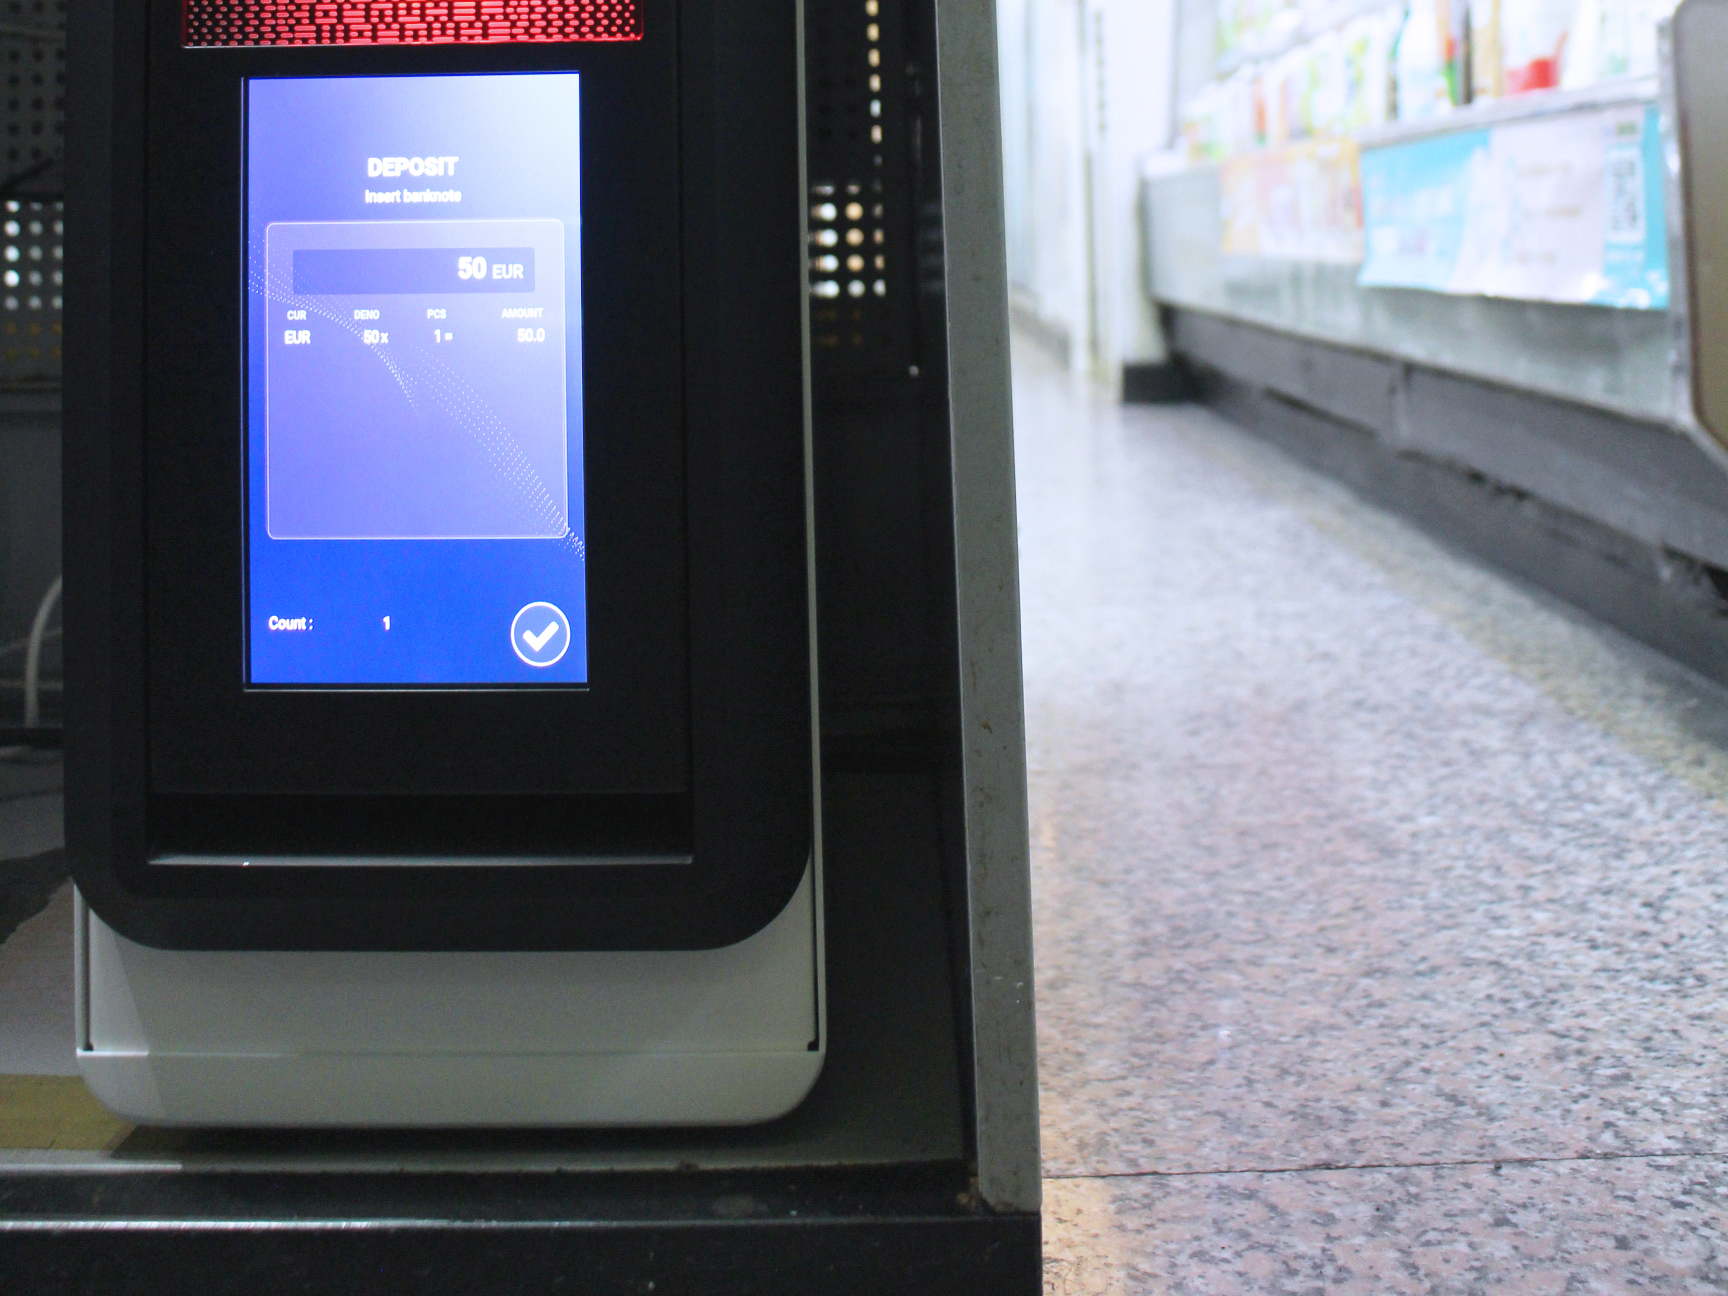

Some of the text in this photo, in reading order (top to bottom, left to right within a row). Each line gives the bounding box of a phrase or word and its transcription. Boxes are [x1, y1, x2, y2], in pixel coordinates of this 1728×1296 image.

[367, 156, 459, 177] DEPOSIT
[365, 188, 462, 203] Insert banknote
[458, 256, 524, 280] 50 EUR
[287, 307, 544, 320] CUR DENO PCS AMOUNT
[284, 330, 311, 344] EUR
[517, 328, 546, 343] 50.0
[382, 615, 391, 631] 1
